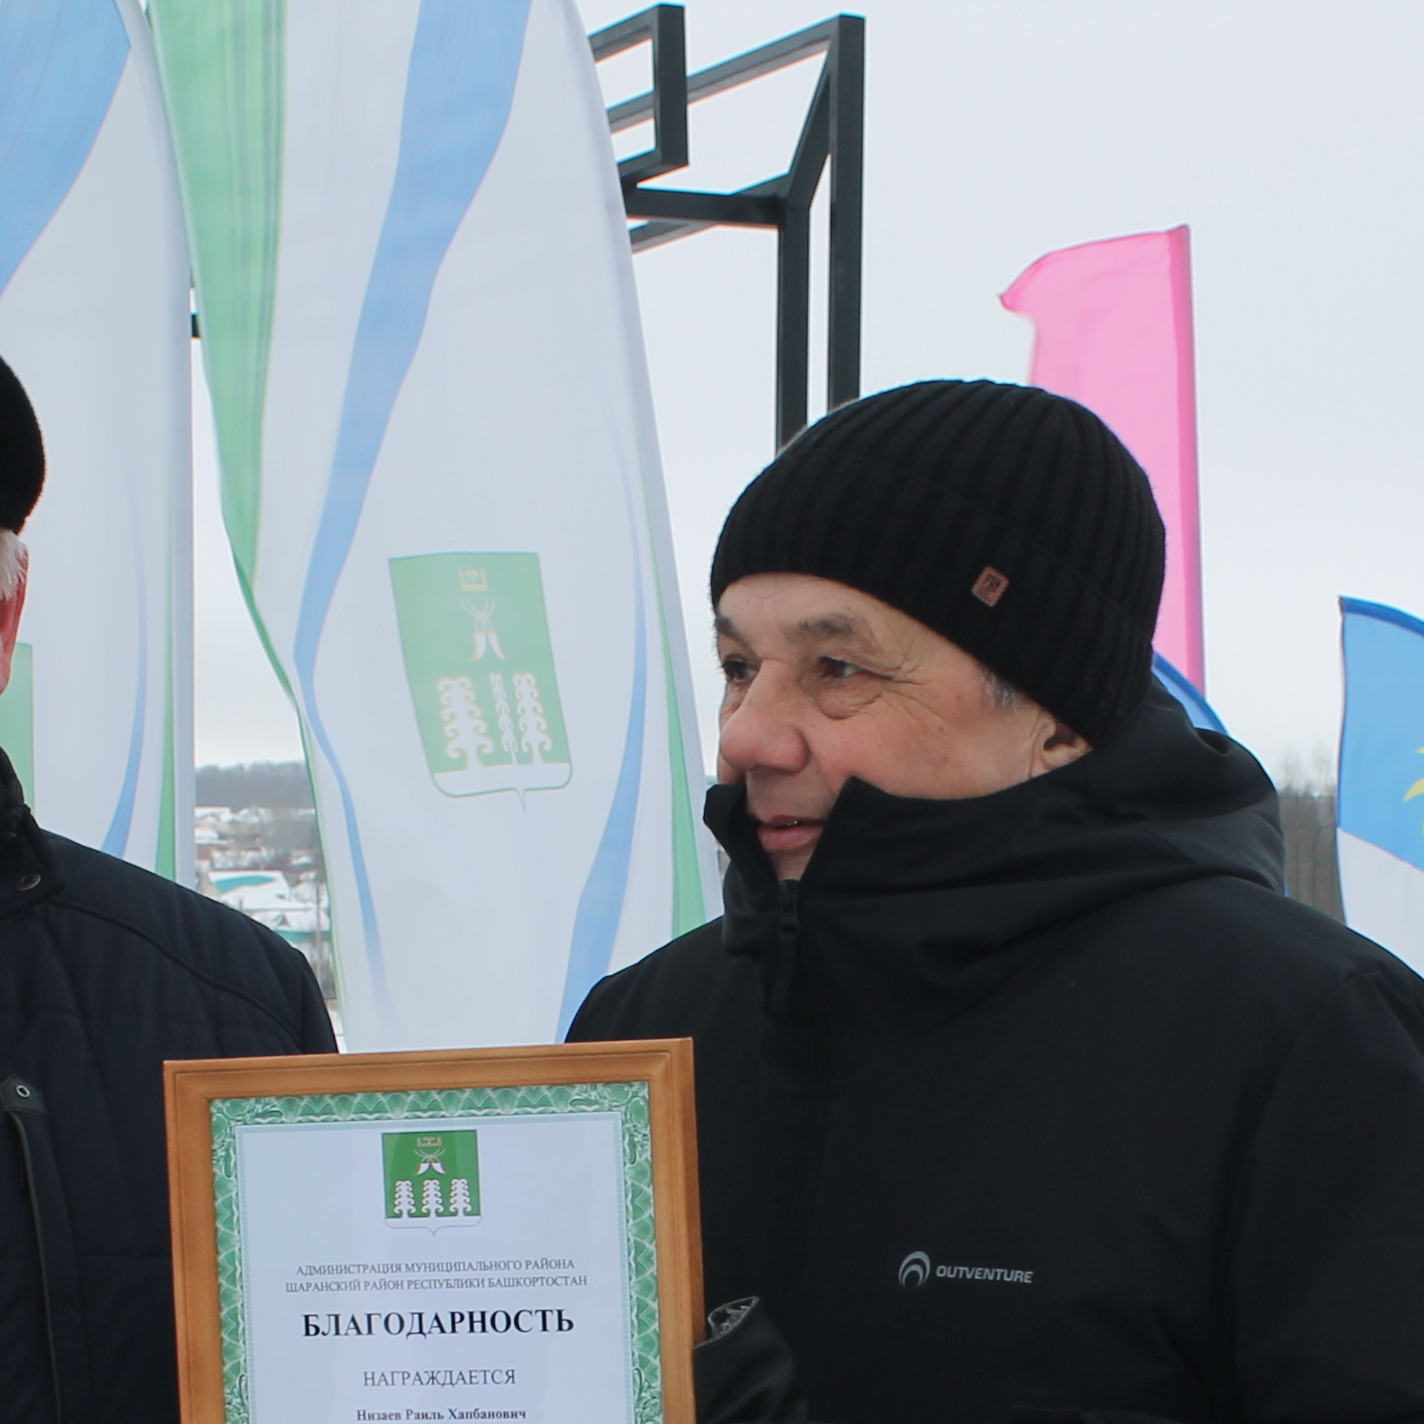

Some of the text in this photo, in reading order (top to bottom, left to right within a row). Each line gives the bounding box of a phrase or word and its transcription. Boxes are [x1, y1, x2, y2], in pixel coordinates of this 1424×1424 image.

[297, 1257, 574, 1275] АДМИНИСТРАЦИЯ МУНИЦИПАЛЬНОГО РАЙОНА
[936, 1265, 1034, 1284] OUTVENTURE
[286, 1275, 586, 1292] ШАРАНСКИЙ РАЙОН РЕСПУБЛИКИ БАШКОРТОСТАН
[302, 1309, 574, 1340] БЛАГОДАРНОСТЬ
[363, 1369, 515, 1387] НАГРАЖДАЕТСЯ
